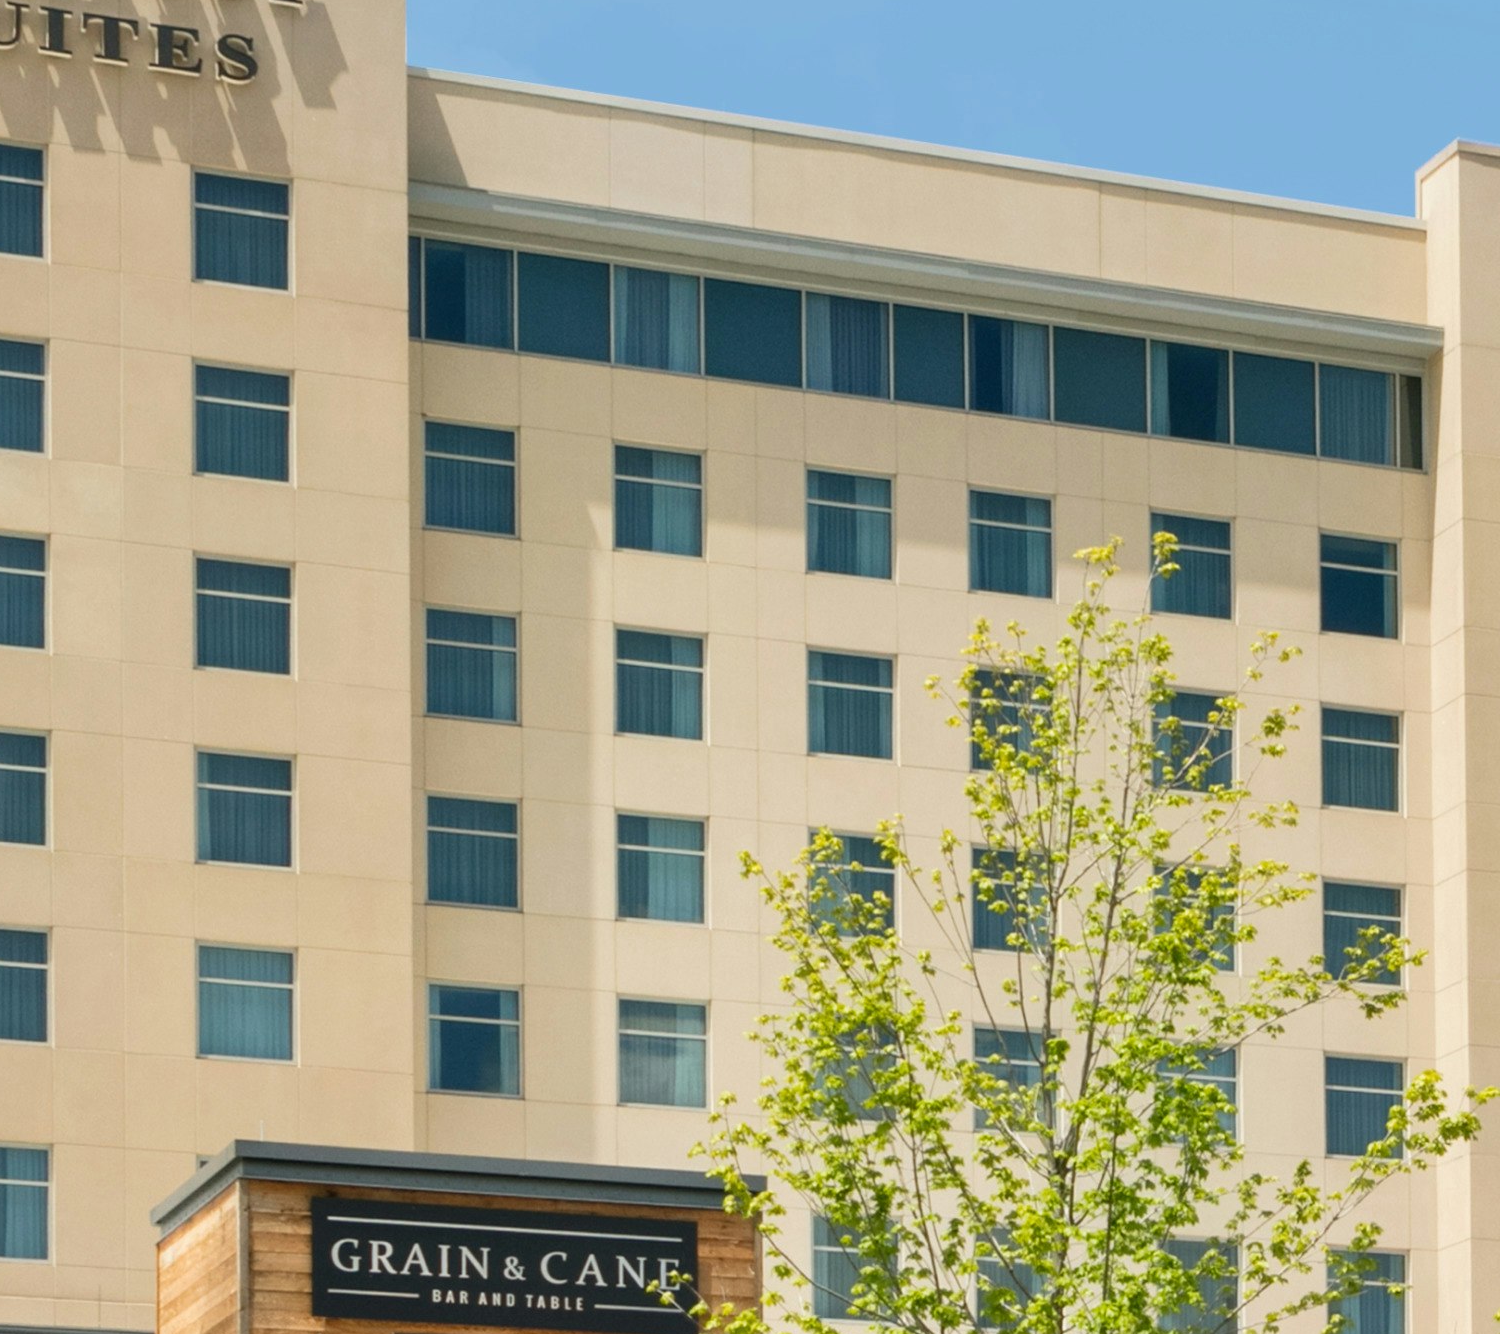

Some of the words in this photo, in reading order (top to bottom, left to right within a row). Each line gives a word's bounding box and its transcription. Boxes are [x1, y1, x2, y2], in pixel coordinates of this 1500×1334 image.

[330, 1237, 491, 1281] GRAIN
[503, 1255, 527, 1281] &
[540, 1251, 682, 1292] CANE
[432, 1288, 469, 1306] BAR
[478, 1291, 516, 1308] AND
[525, 1294, 585, 1312] TABLE
